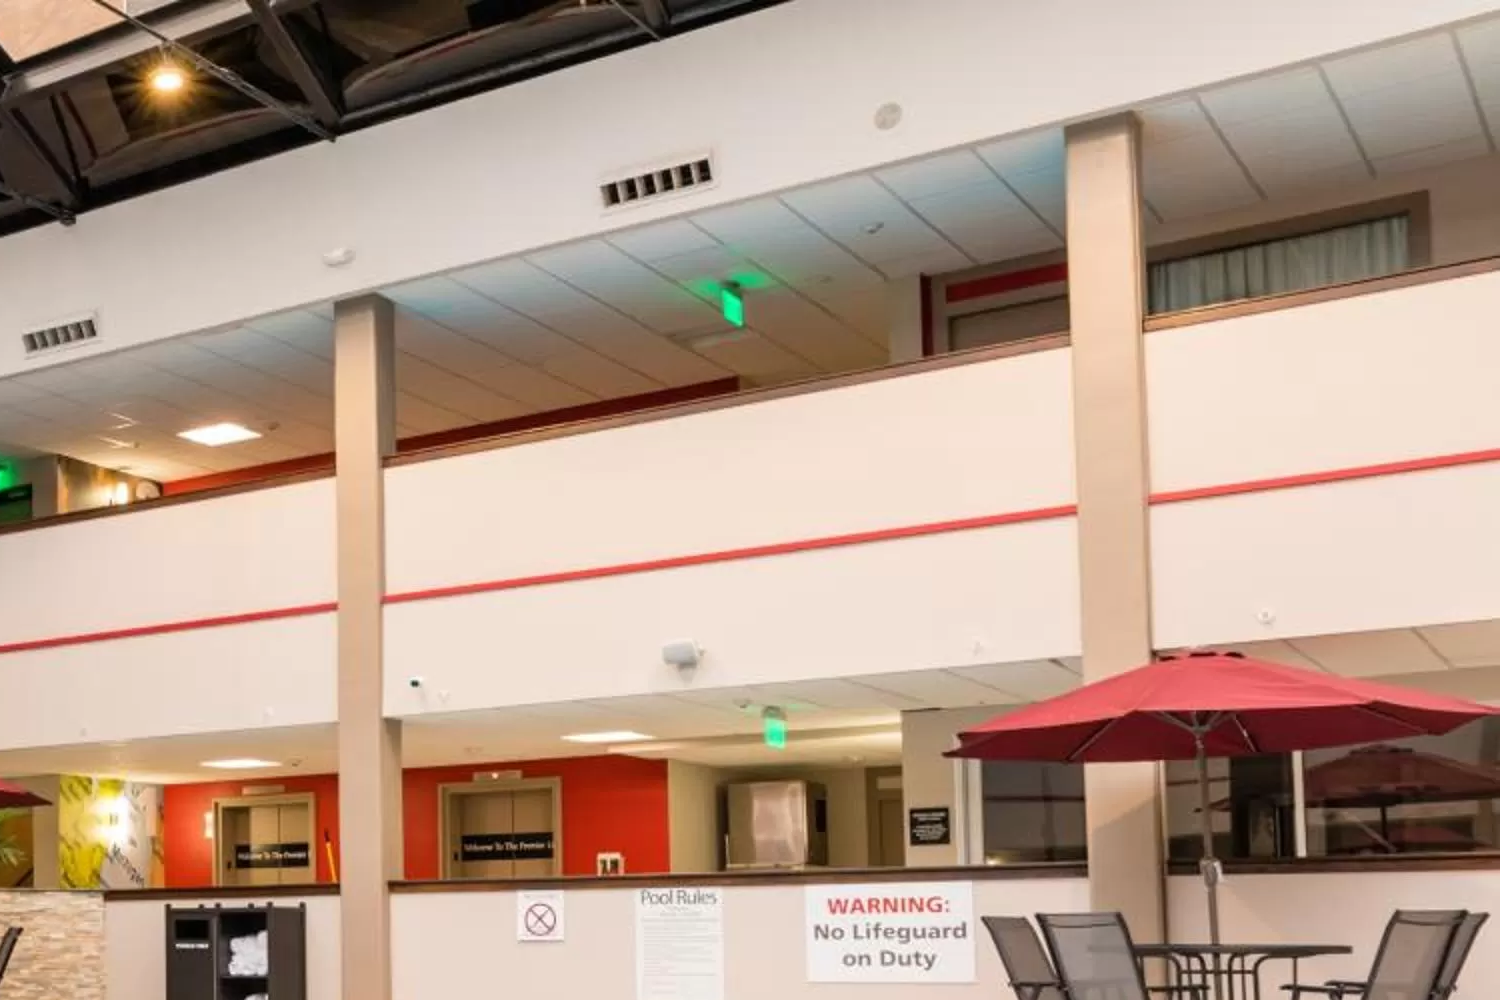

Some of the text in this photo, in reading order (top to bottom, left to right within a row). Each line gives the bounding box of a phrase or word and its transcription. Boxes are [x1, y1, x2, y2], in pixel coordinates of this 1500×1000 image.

[641, 888, 718, 905] Pool Rules
[827, 896, 951, 915] WARNING:
[814, 921, 967, 944] No Lifeguard
[842, 950, 937, 971] on Duty
